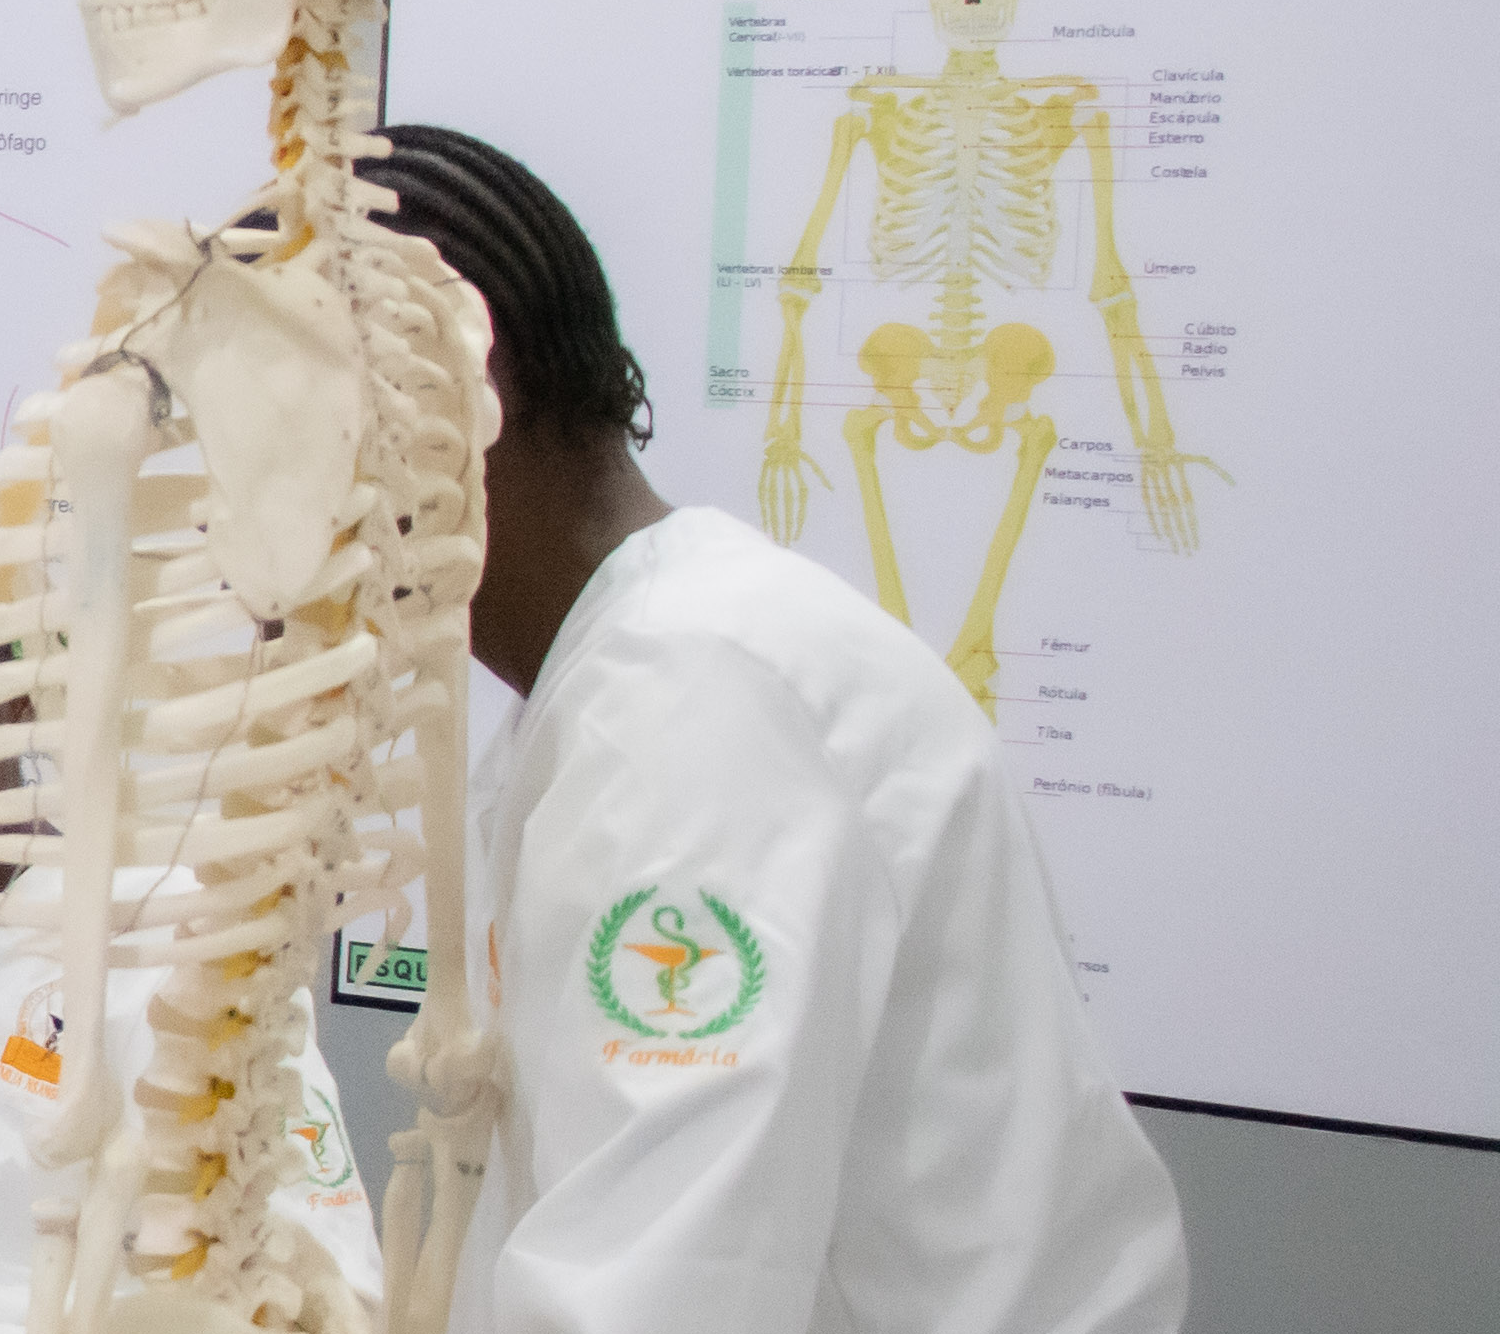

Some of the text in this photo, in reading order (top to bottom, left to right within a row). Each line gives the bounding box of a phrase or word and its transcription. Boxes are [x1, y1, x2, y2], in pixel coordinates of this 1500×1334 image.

[1152, 68, 1224, 82] Clavícula
[1059, 437, 1113, 453] Carpos
[1044, 467, 1134, 483] Metacarpos
[1042, 492, 1111, 509] Falanges
